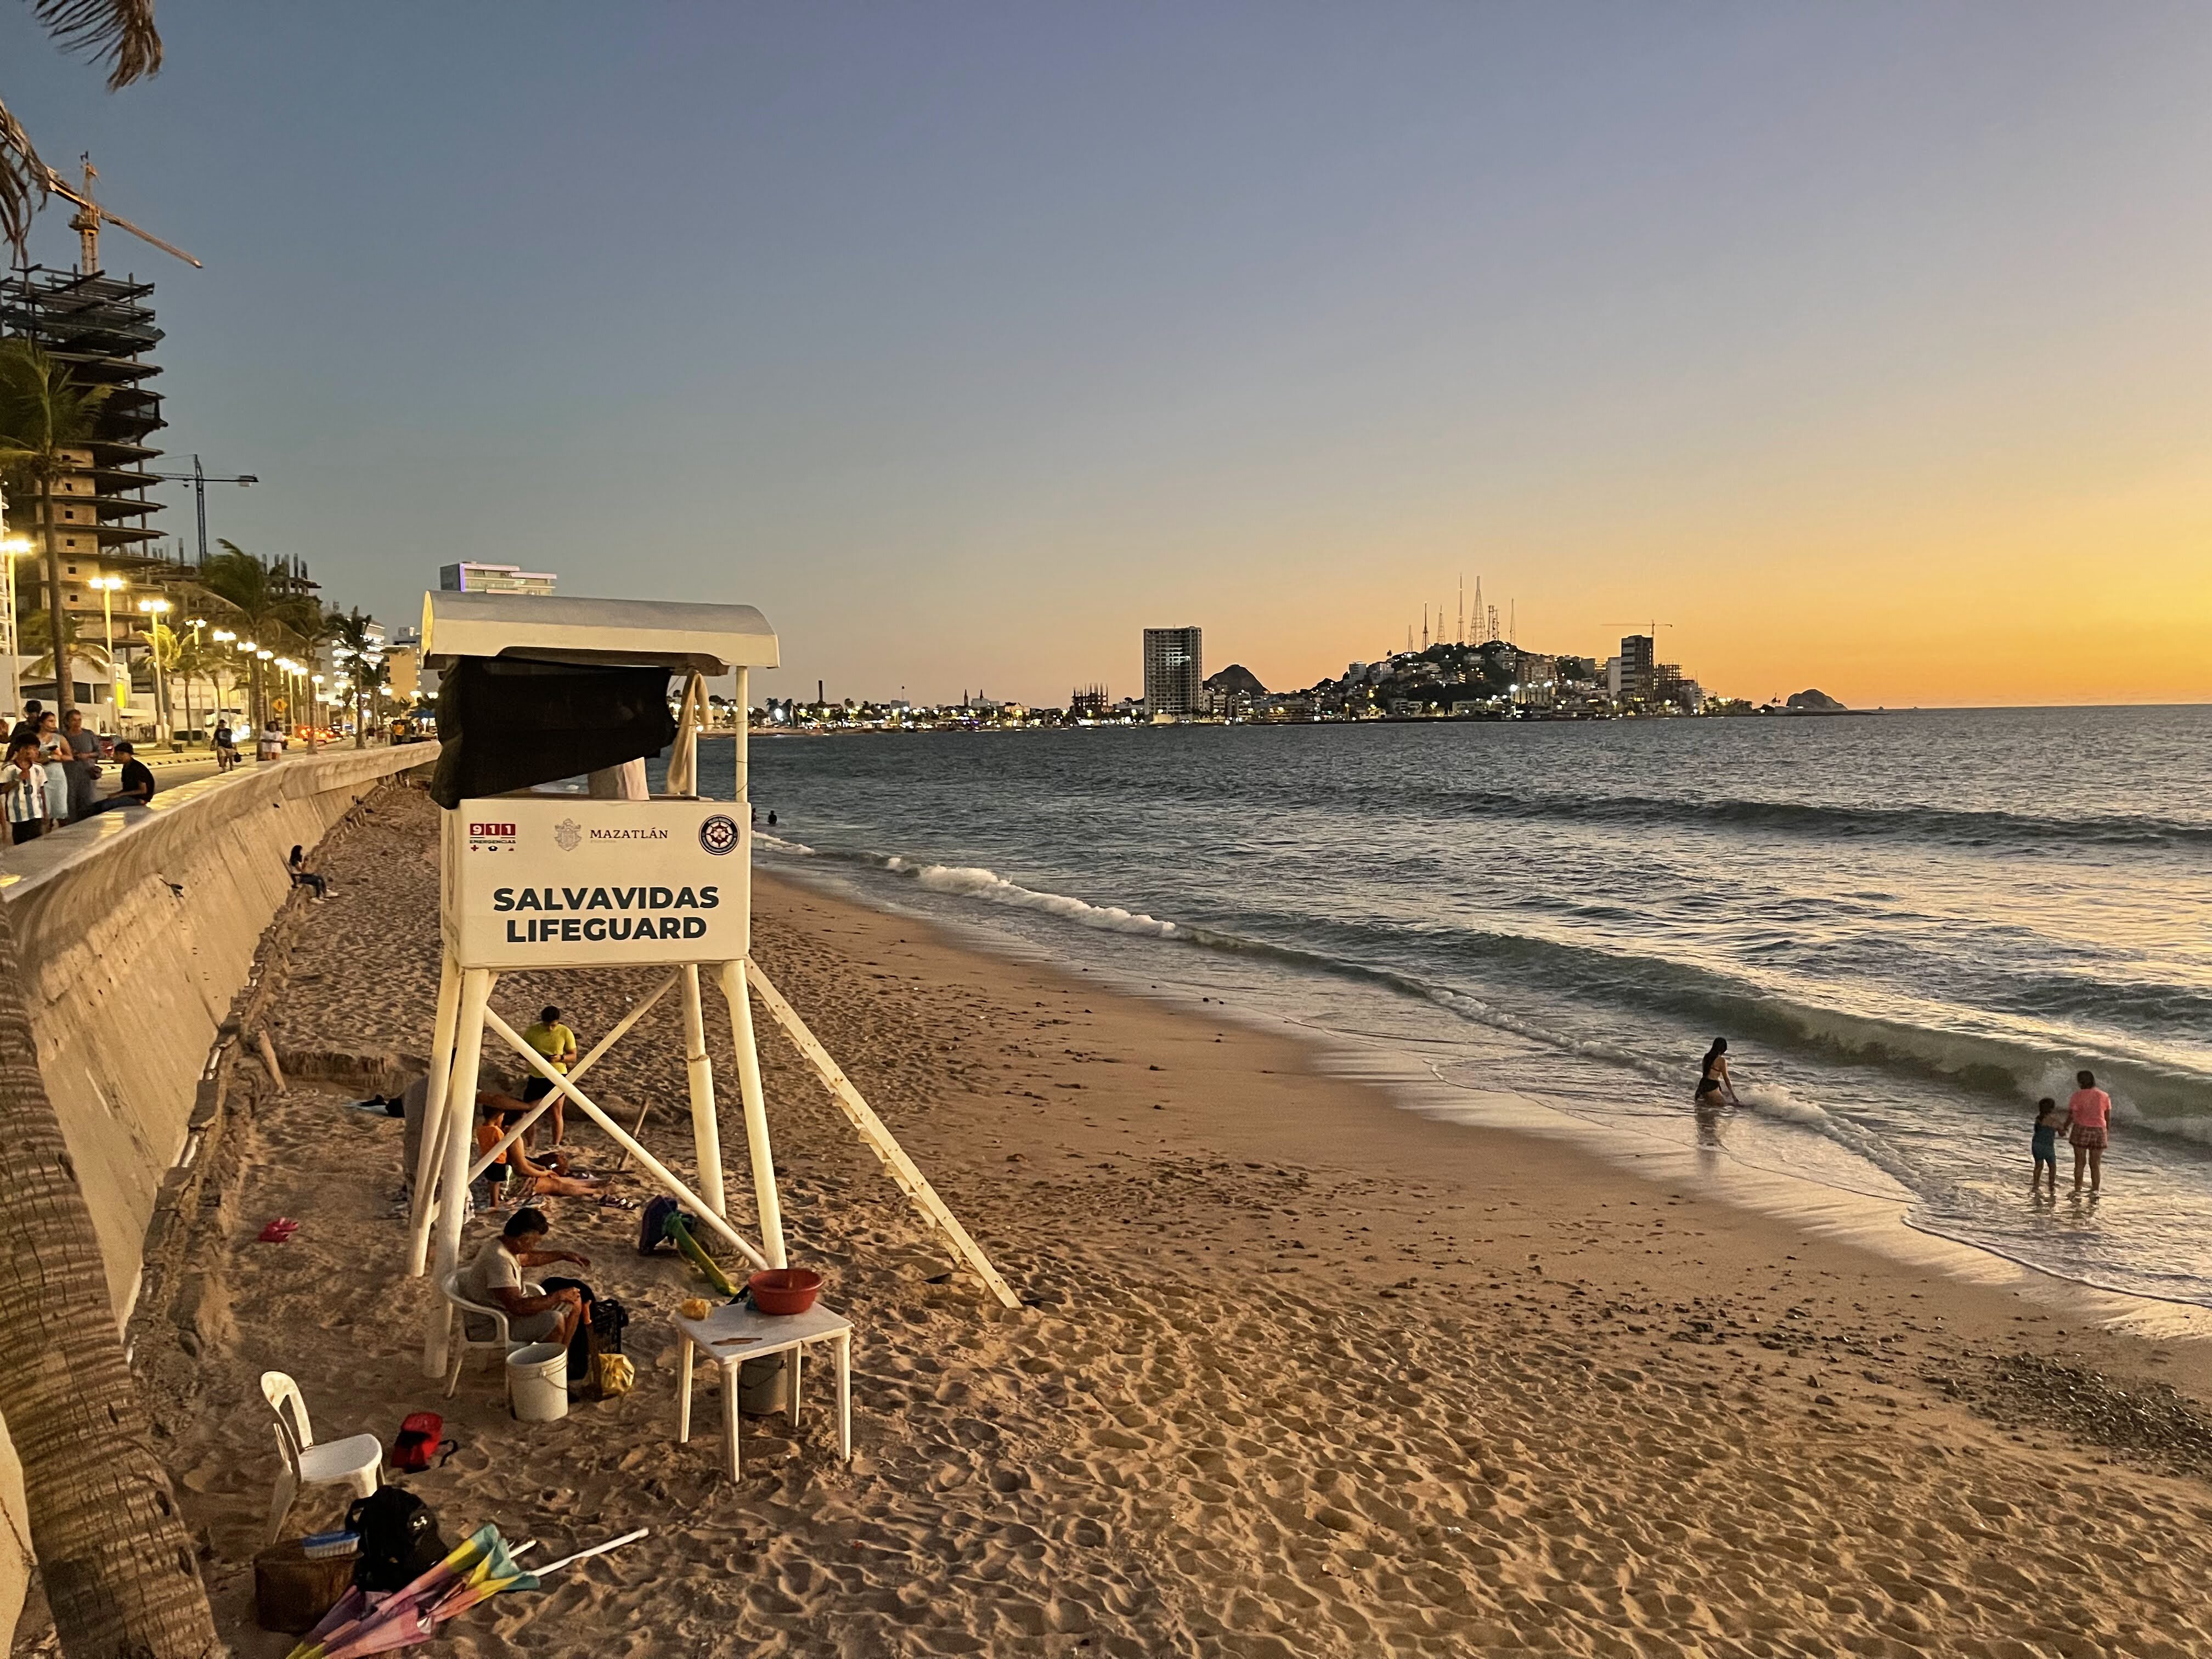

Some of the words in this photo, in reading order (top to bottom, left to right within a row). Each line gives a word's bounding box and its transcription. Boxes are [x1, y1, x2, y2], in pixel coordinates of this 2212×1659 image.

[472, 825, 511, 834] 911
[590, 827, 668, 839] MAZATLÁN
[493, 886, 719, 912] SALVAVIDAS
[507, 917, 707, 943] LIFEGUARD
